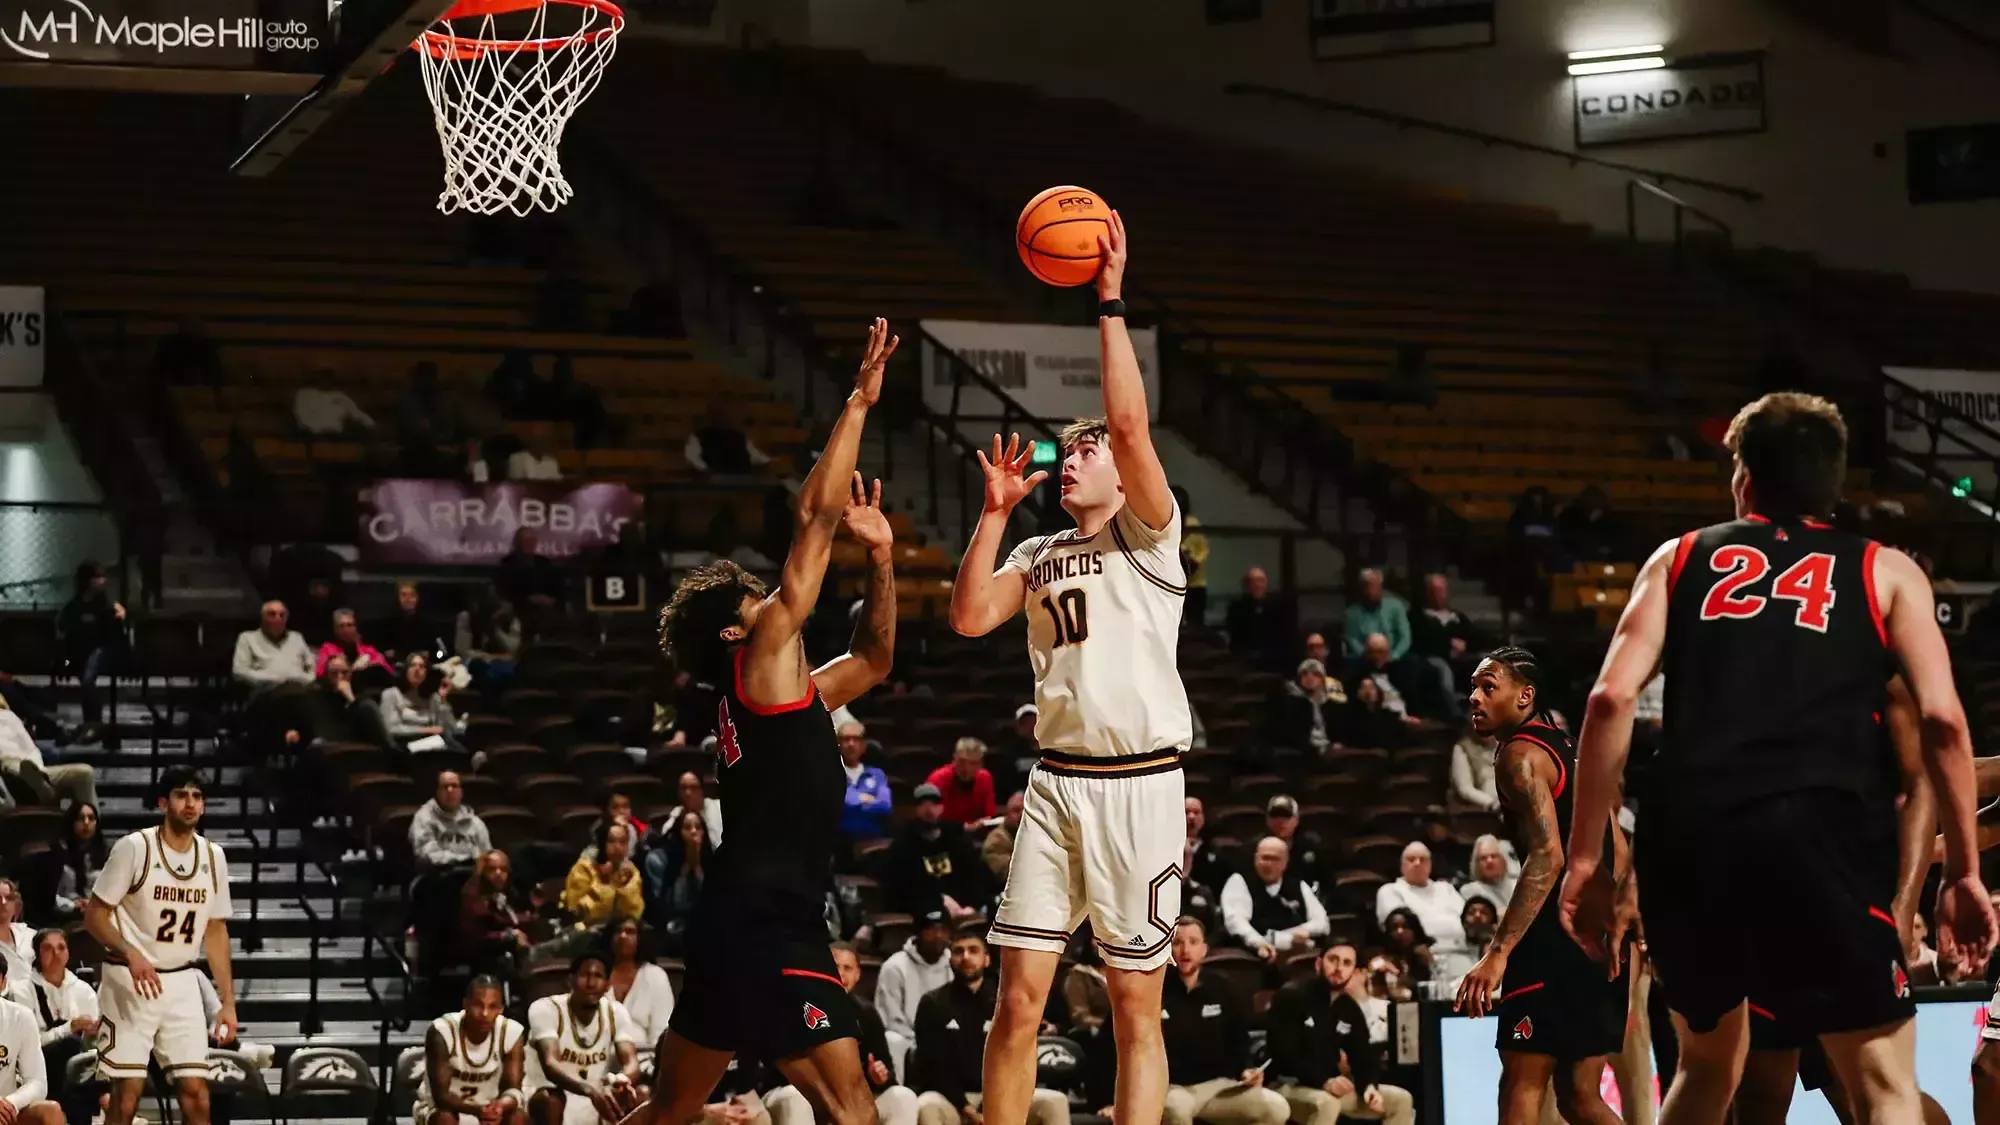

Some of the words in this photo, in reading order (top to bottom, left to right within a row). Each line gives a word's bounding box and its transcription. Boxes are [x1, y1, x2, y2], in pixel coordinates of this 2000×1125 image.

[266, 19, 308, 35] auto
[266, 35, 320, 53] group
[1581, 81, 1758, 115] CONDADO
[1058, 196, 1094, 208] PRO
[0, 312, 41, 347] K'S
[605, 576, 627, 601] B
[1700, 544, 1837, 634] 24
[1040, 587, 1089, 650] 10
[1936, 602, 1952, 625] C
[153, 885, 207, 904] BRONCOS
[155, 908, 197, 944] 24
